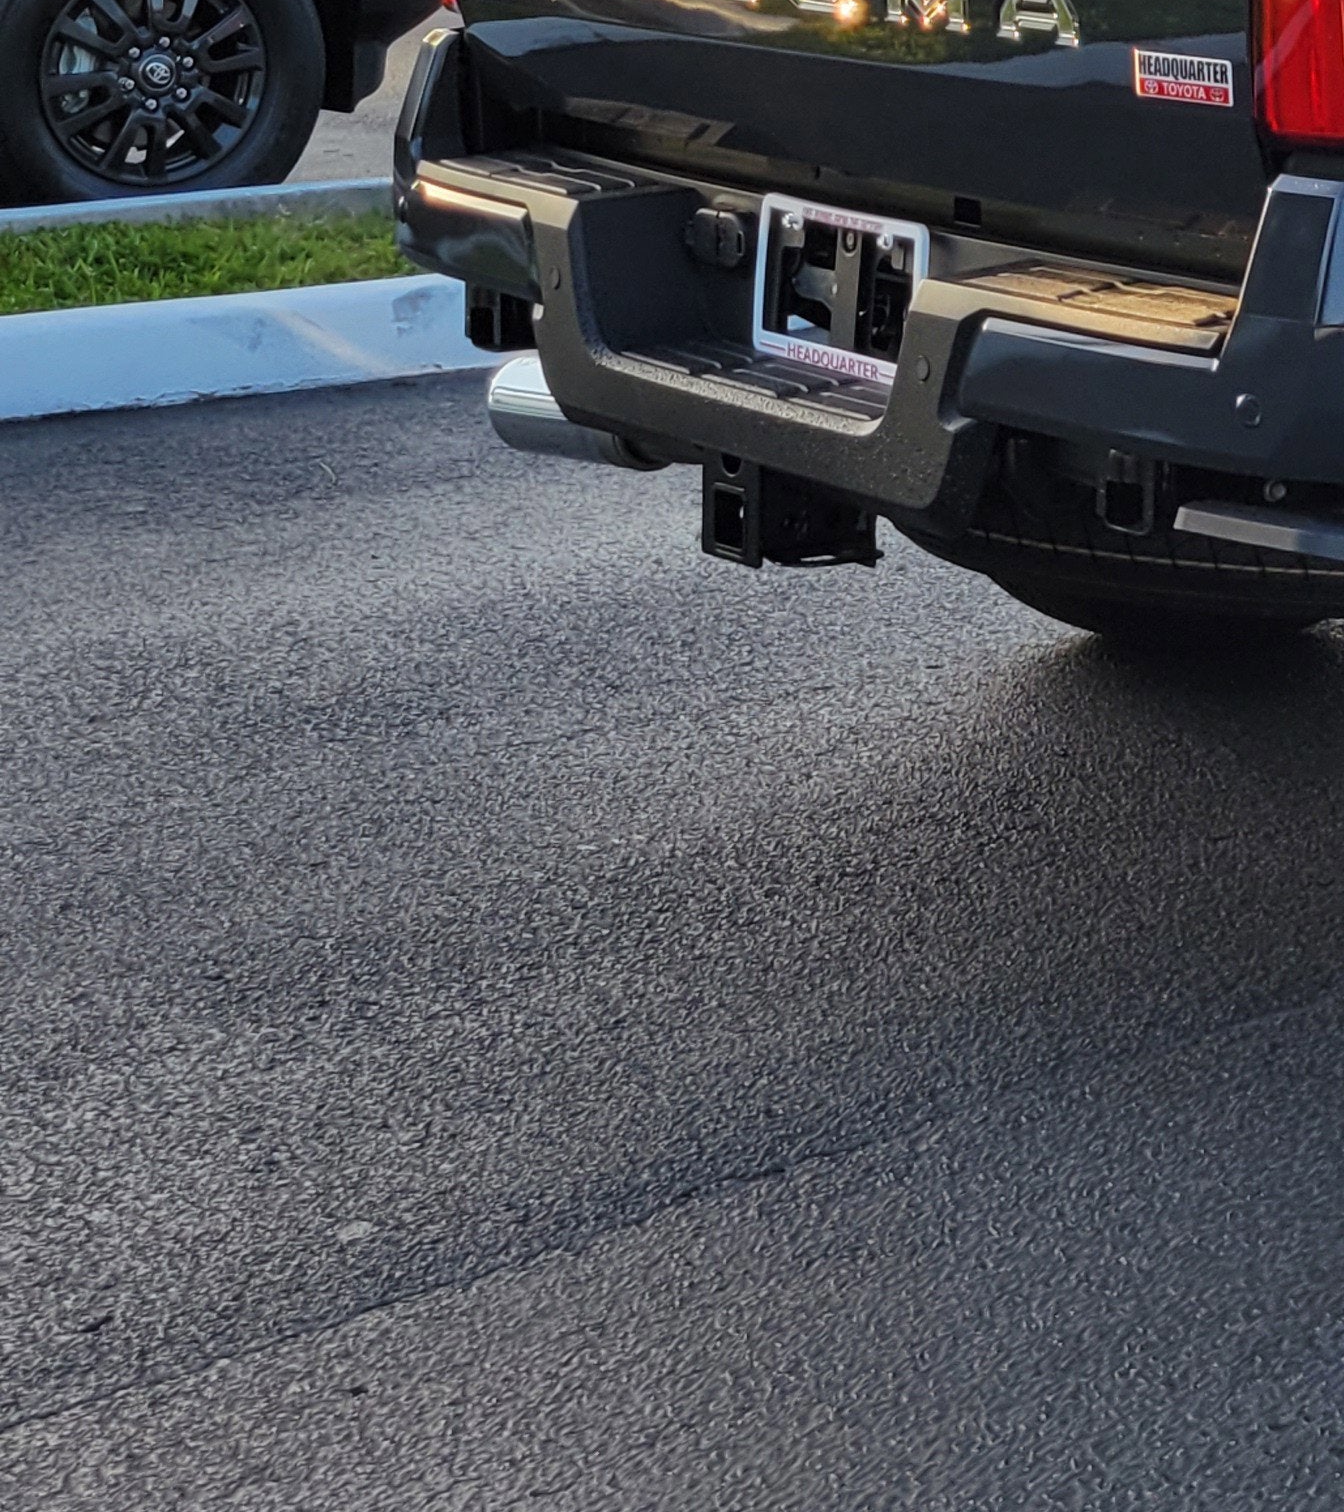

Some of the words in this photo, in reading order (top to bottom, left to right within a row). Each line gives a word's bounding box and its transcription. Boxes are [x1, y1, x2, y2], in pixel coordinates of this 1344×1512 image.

[1139, 55, 1229, 84] HEADQUARTER
[1161, 82, 1207, 100] TOYOTA
[787, 342, 880, 380] HEADQUARTER
